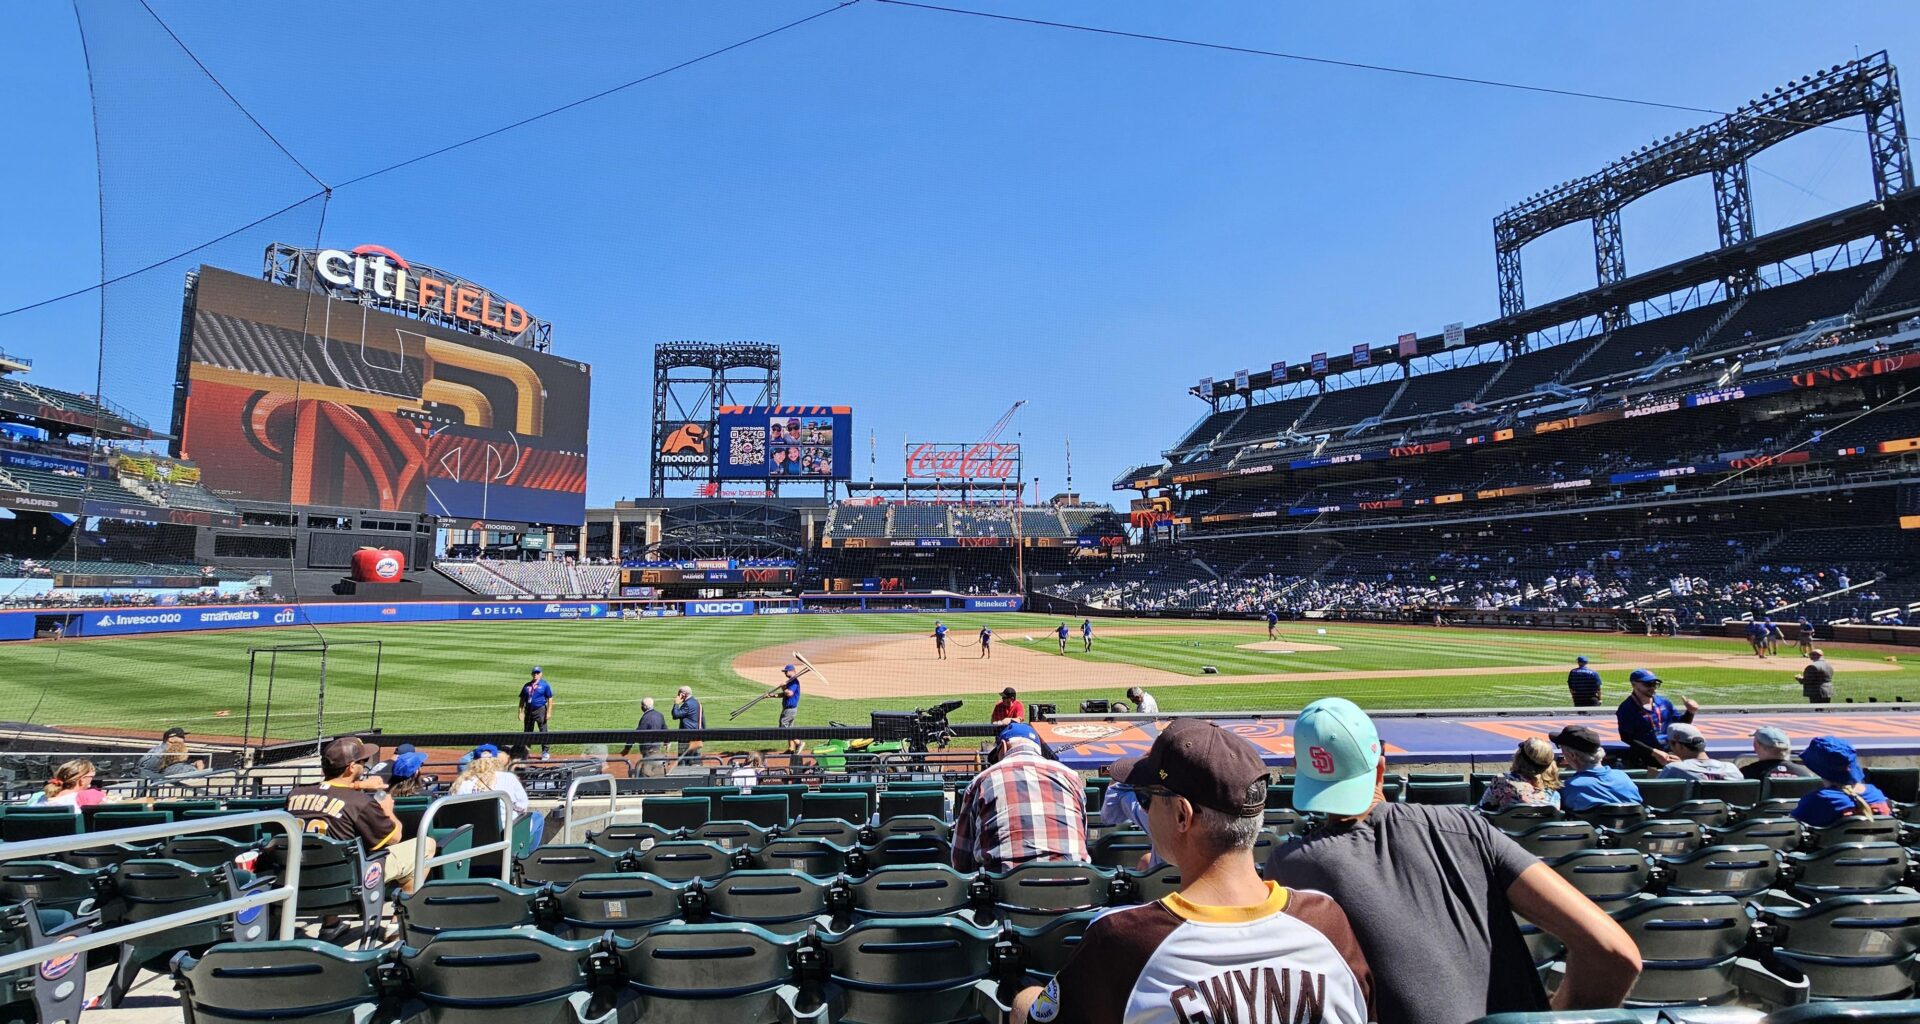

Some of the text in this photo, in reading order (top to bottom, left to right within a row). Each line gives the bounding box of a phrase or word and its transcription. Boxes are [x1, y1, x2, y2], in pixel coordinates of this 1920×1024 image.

[419, 277, 528, 333] FIELD
[201, 360, 273, 377] PADRES
[1695, 386, 1742, 398] NEW YORK
[1696, 390, 1745, 406] METS
[1624, 402, 1680, 418] PADRES
[400, 411, 450, 424] VERSUS
[559, 450, 585, 458] METS
[661, 455, 708, 463] moomoo
[1331, 453, 1361, 464] METS
[10, 456, 25, 465] THE
[1240, 465, 1273, 475] PADRES
[1659, 466, 1695, 477] METS
[1553, 479, 1591, 490] PADRES
[16, 497, 58, 508] PADRES
[120, 508, 147, 516] METS
[1252, 510, 1277, 518] PADRES
[1318, 505, 1340, 513] METS
[695, 603, 743, 614] NOCO
[975, 600, 1007, 608] Heineken
[200, 611, 252, 622] smartwater
[484, 607, 523, 615] DELTA
[116, 613, 182, 625] Invesco QQQ
[1308, 746, 1335, 774] SD
[287, 794, 343, 819] TATIS JR.
[1169, 967, 1326, 1024] GWYNN
